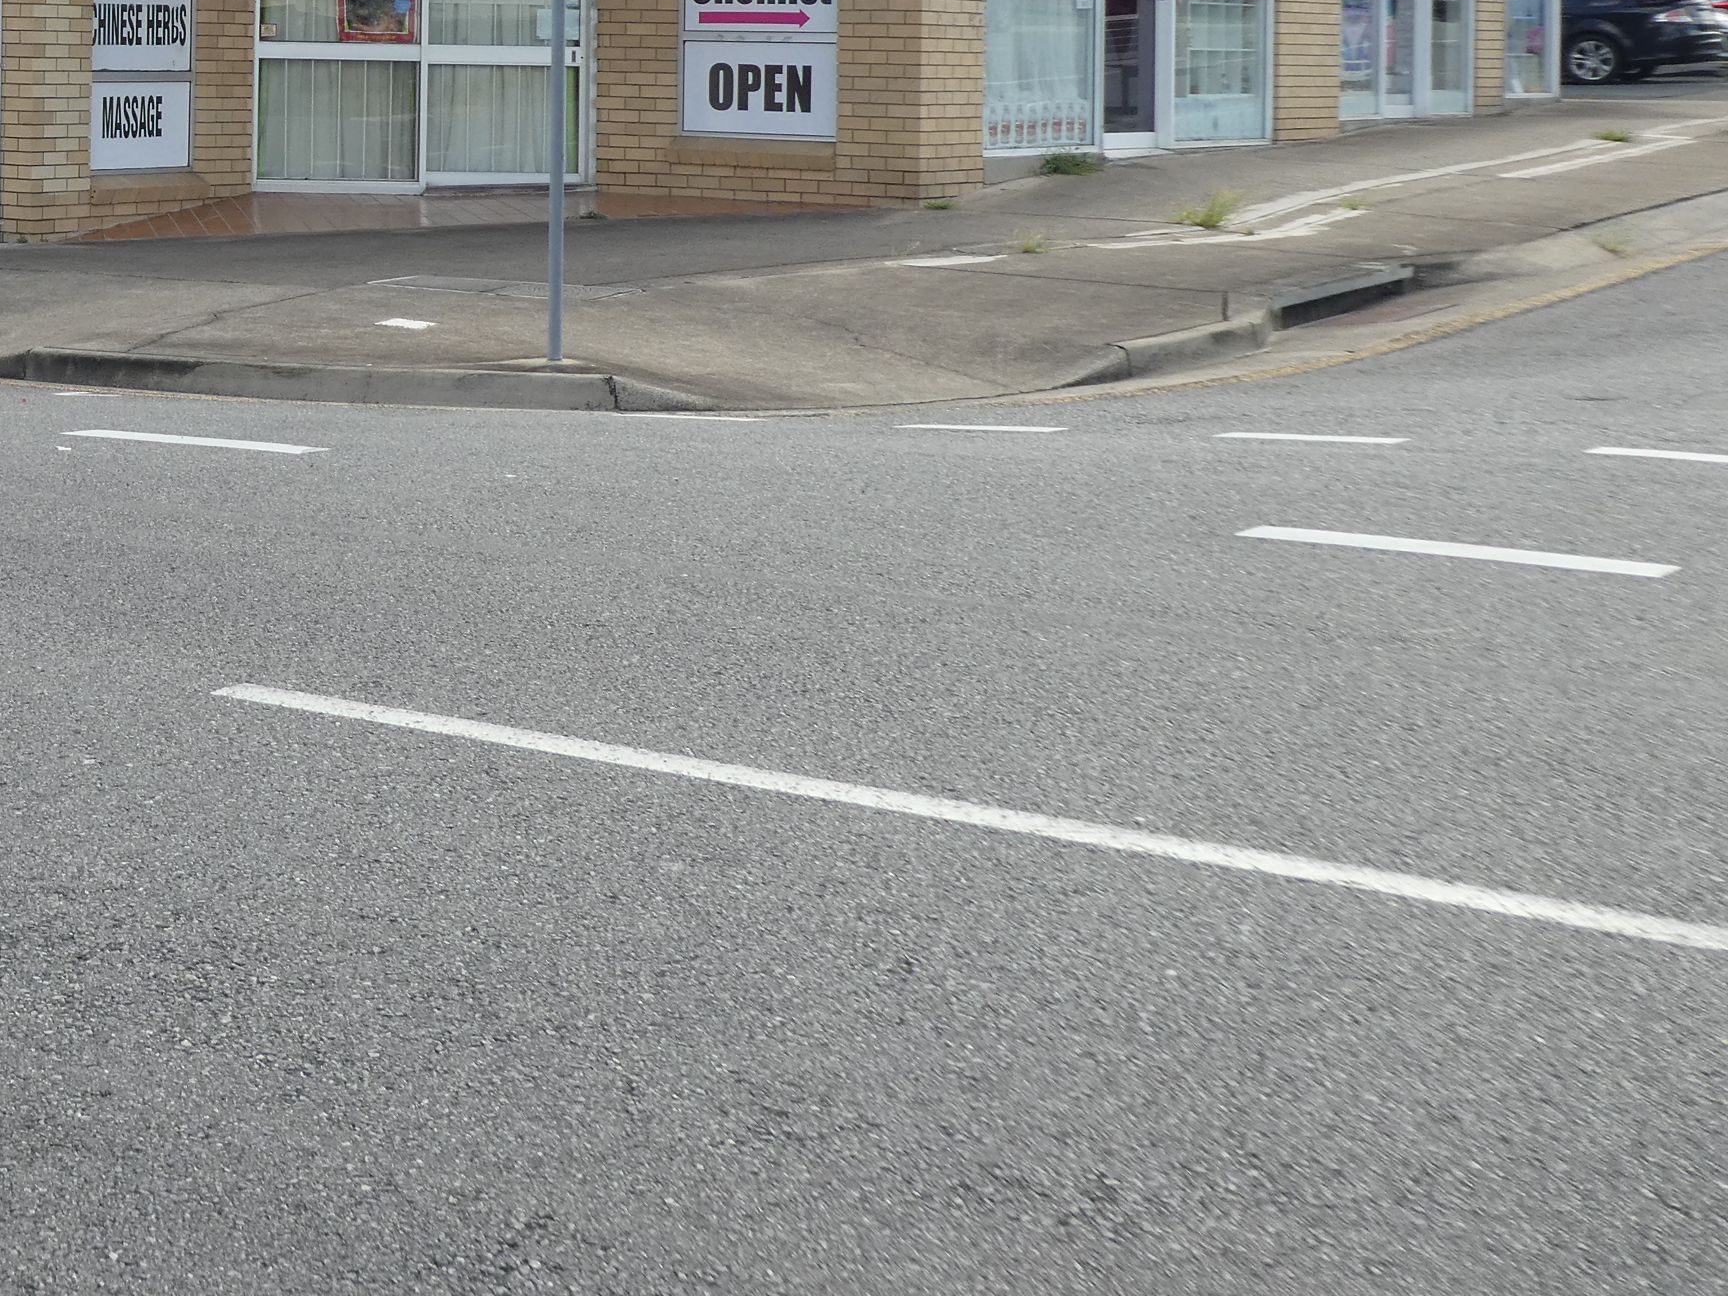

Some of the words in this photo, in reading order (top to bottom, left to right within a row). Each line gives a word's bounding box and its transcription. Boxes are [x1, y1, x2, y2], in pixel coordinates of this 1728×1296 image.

[92, 3, 142, 47] CHINESE
[708, 62, 812, 113] OPEN
[101, 95, 163, 139] MASSAGE
